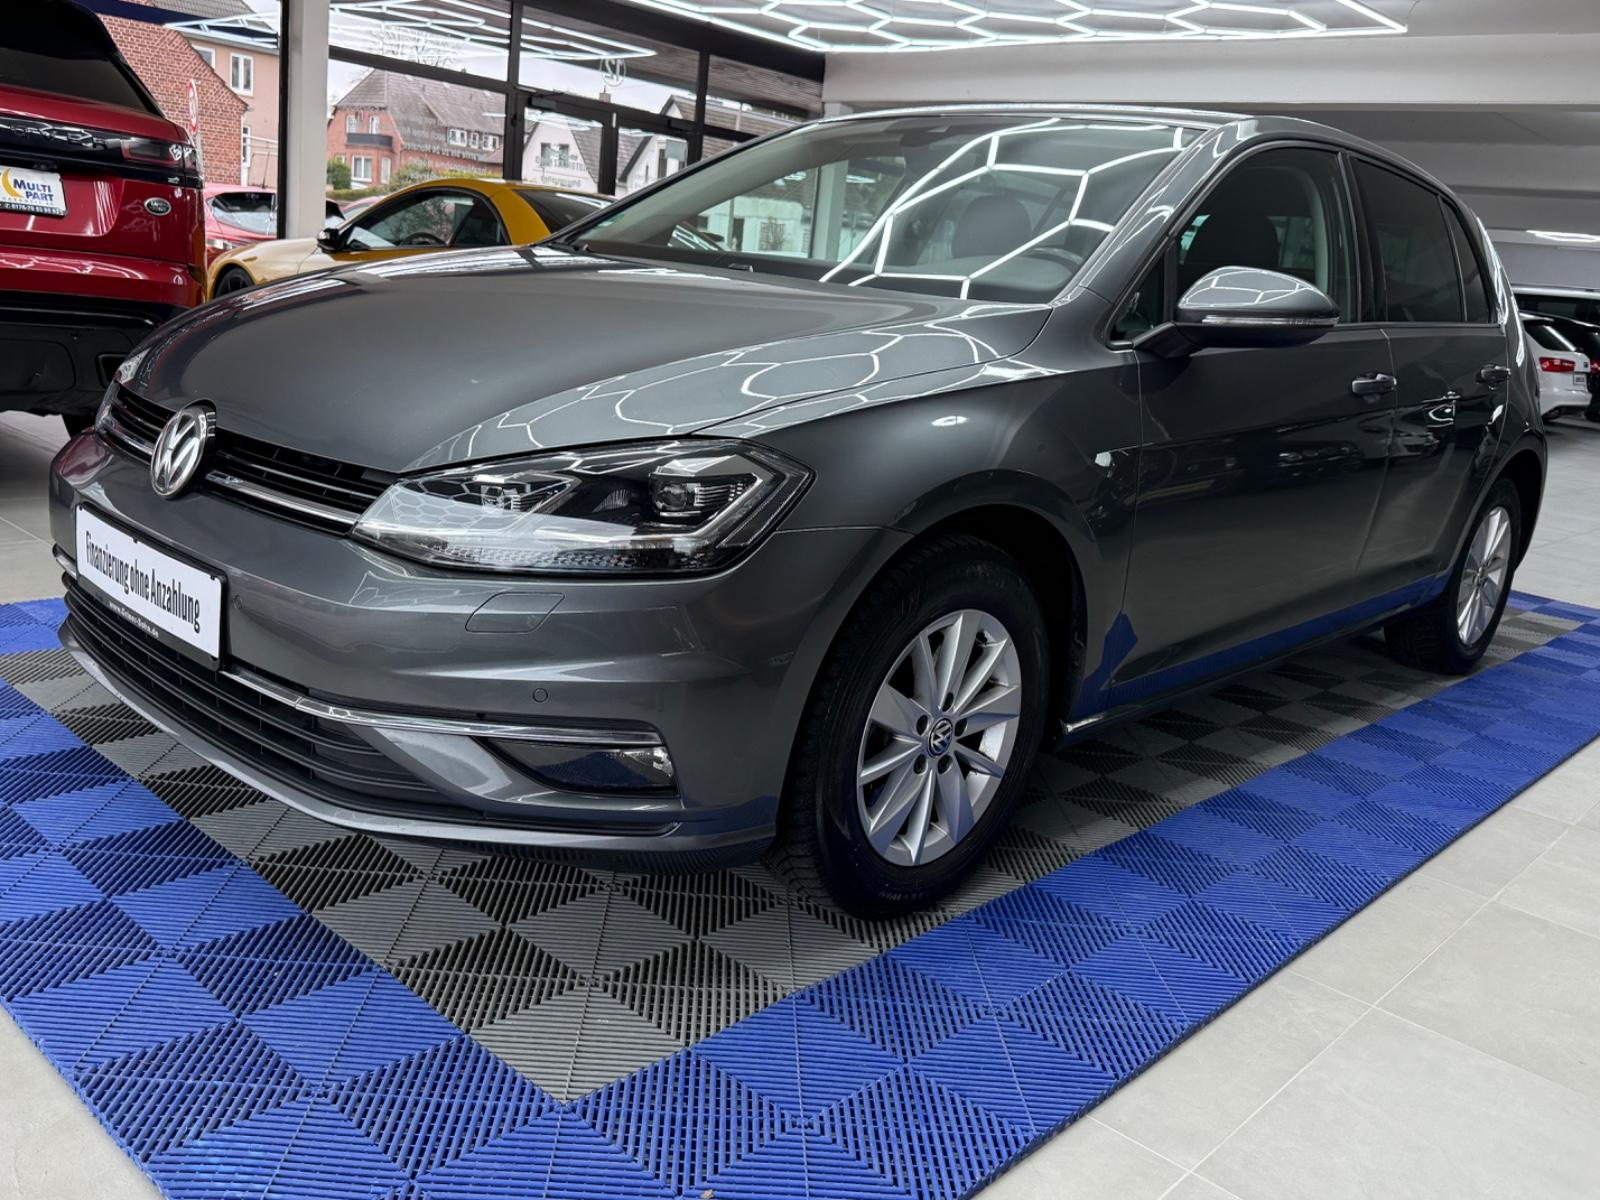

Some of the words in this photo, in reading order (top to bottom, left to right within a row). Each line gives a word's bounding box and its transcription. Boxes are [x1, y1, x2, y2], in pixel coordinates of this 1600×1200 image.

[13, 179, 51, 193] MULTI
[25, 191, 54, 202] PART
[85, 530, 130, 595] Finanzierung
[130, 558, 150, 601] ohne
[150, 568, 201, 634] Anzahlung
